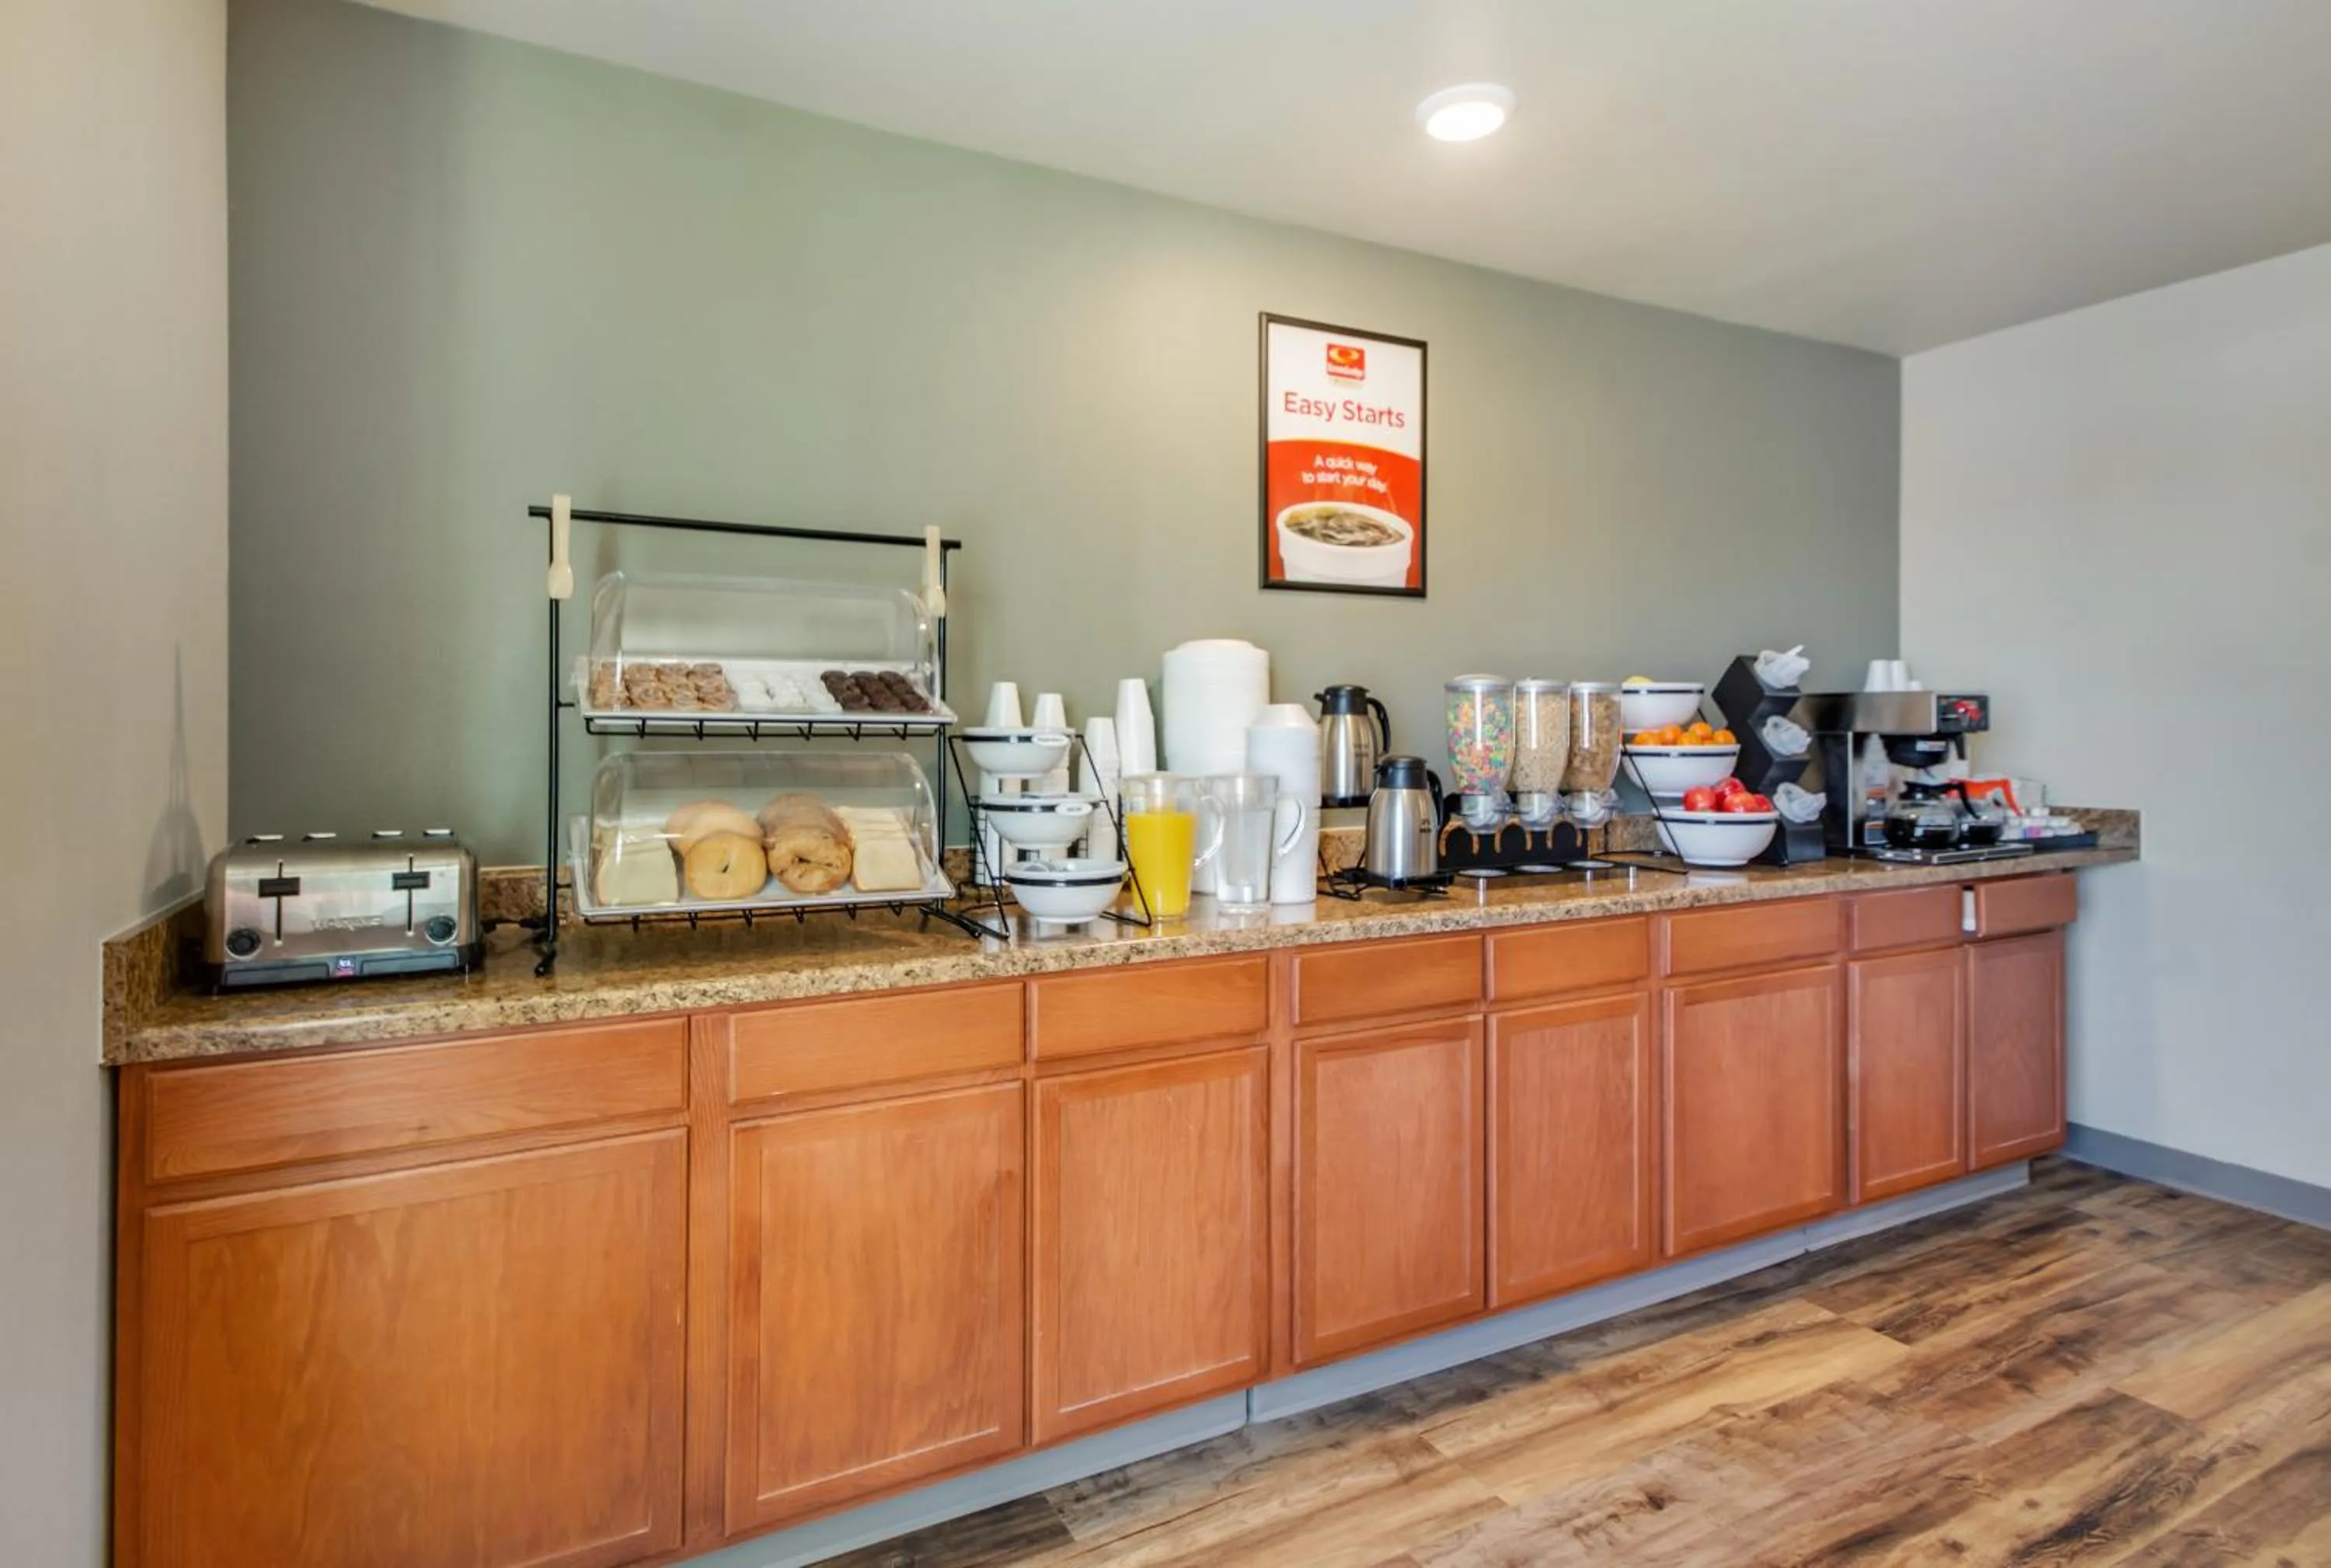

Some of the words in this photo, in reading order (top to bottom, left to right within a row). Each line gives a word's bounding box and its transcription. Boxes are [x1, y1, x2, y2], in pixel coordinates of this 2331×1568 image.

[1284, 391, 1336, 422] Easy
[1342, 399, 1405, 428] Starts
[1314, 455, 1324, 468] A
[1326, 455, 1354, 471] quick
[1354, 461, 1377, 475] way
[1301, 472, 1315, 484] to
[1316, 472, 1340, 484] start
[1342, 474, 1366, 487] your
